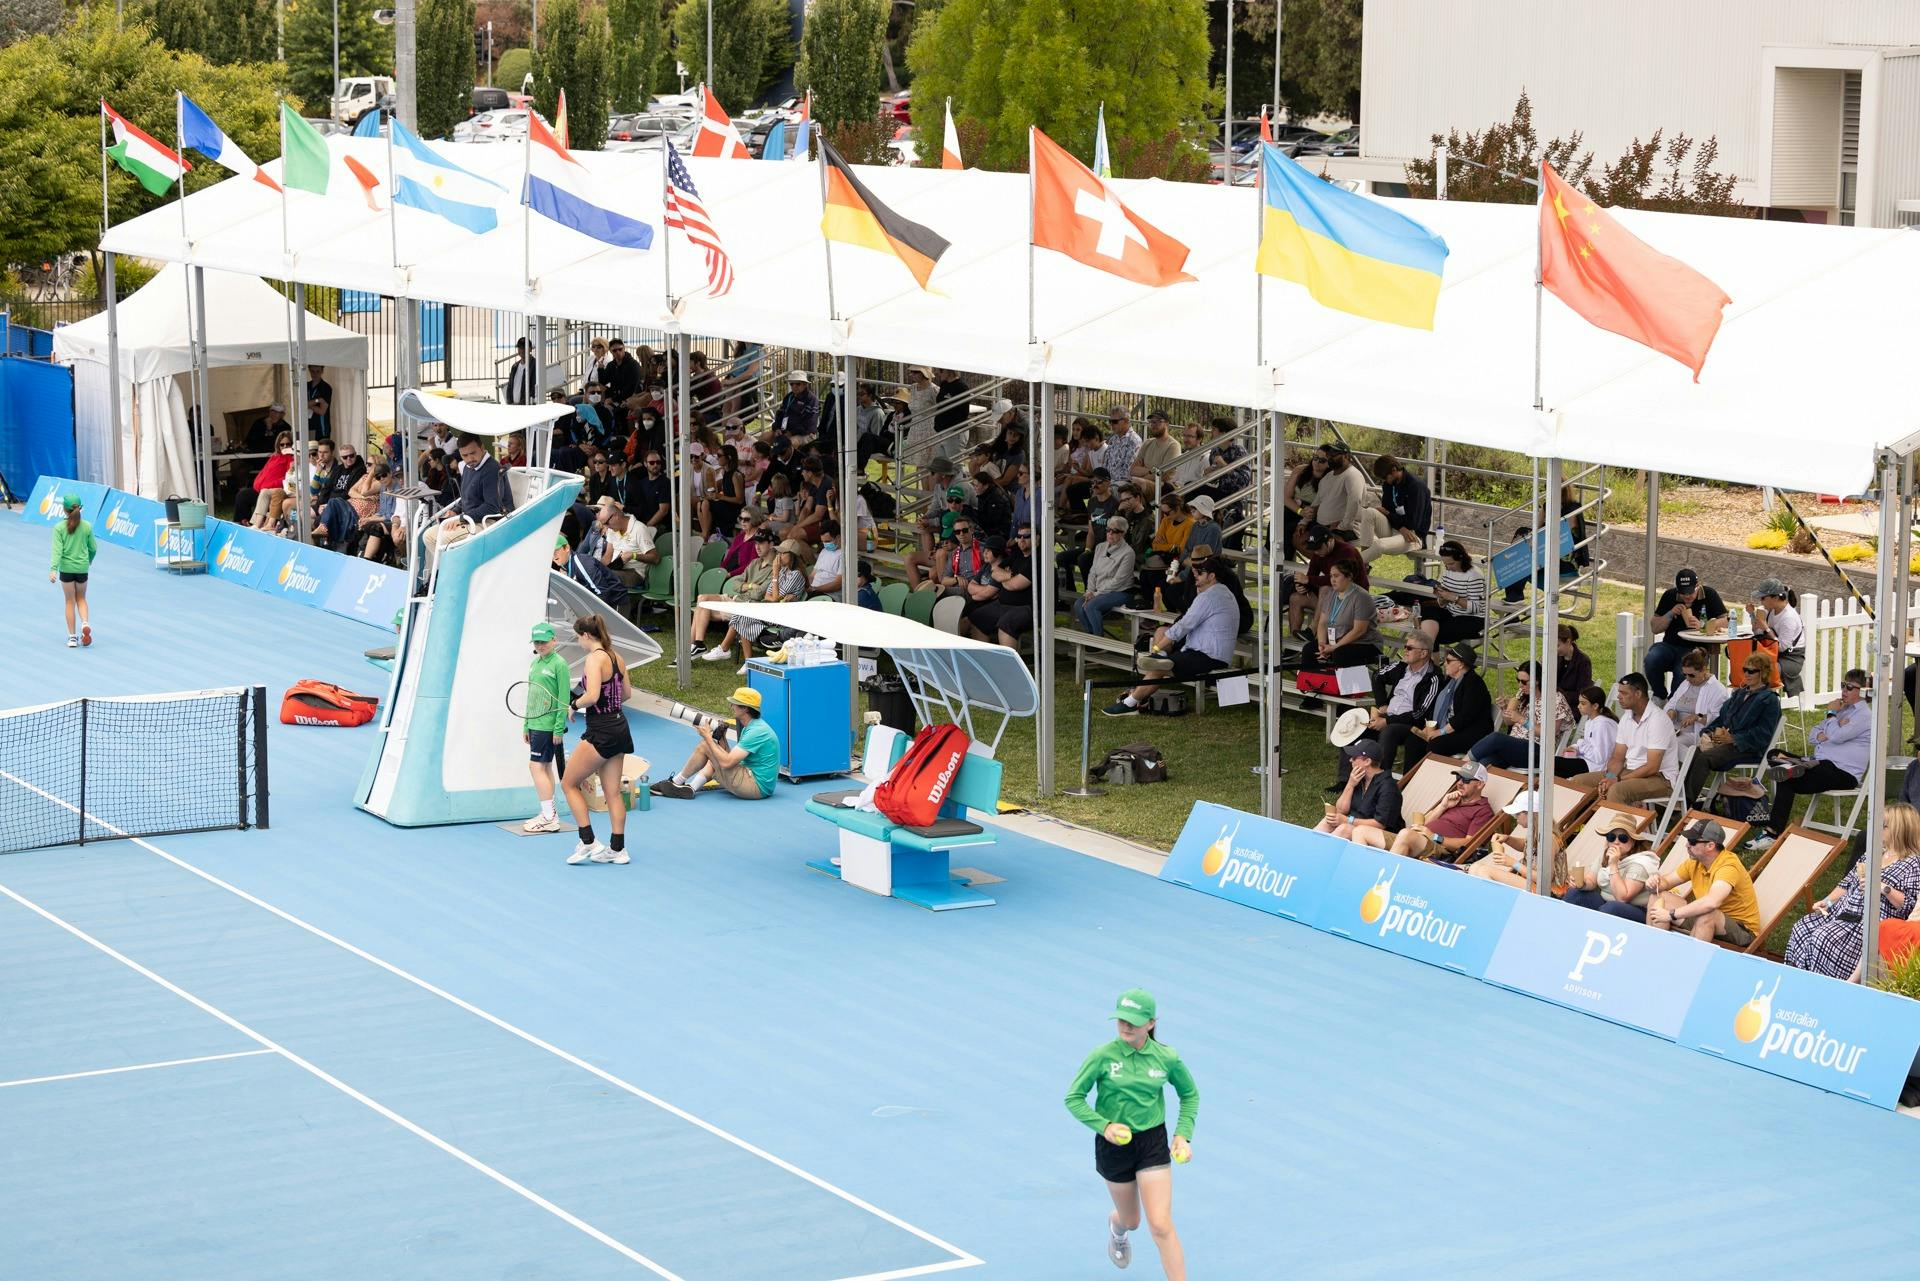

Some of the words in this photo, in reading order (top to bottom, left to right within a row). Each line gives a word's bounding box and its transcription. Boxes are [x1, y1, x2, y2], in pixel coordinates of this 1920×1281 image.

[110, 518, 139, 537] protour
[221, 553, 255, 575] protour
[284, 571, 321, 594] protour
[294, 714, 339, 726] Wilson
[928, 751, 961, 804] Wilson
[1233, 846, 1264, 862] australian
[1219, 858, 1297, 898] protour
[1393, 892, 1428, 909] australian
[1379, 904, 1467, 948] protour
[1562, 983, 1603, 1001] ADVISORY
[1775, 1007, 1818, 1028] australian
[1759, 1023, 1868, 1074] protour
